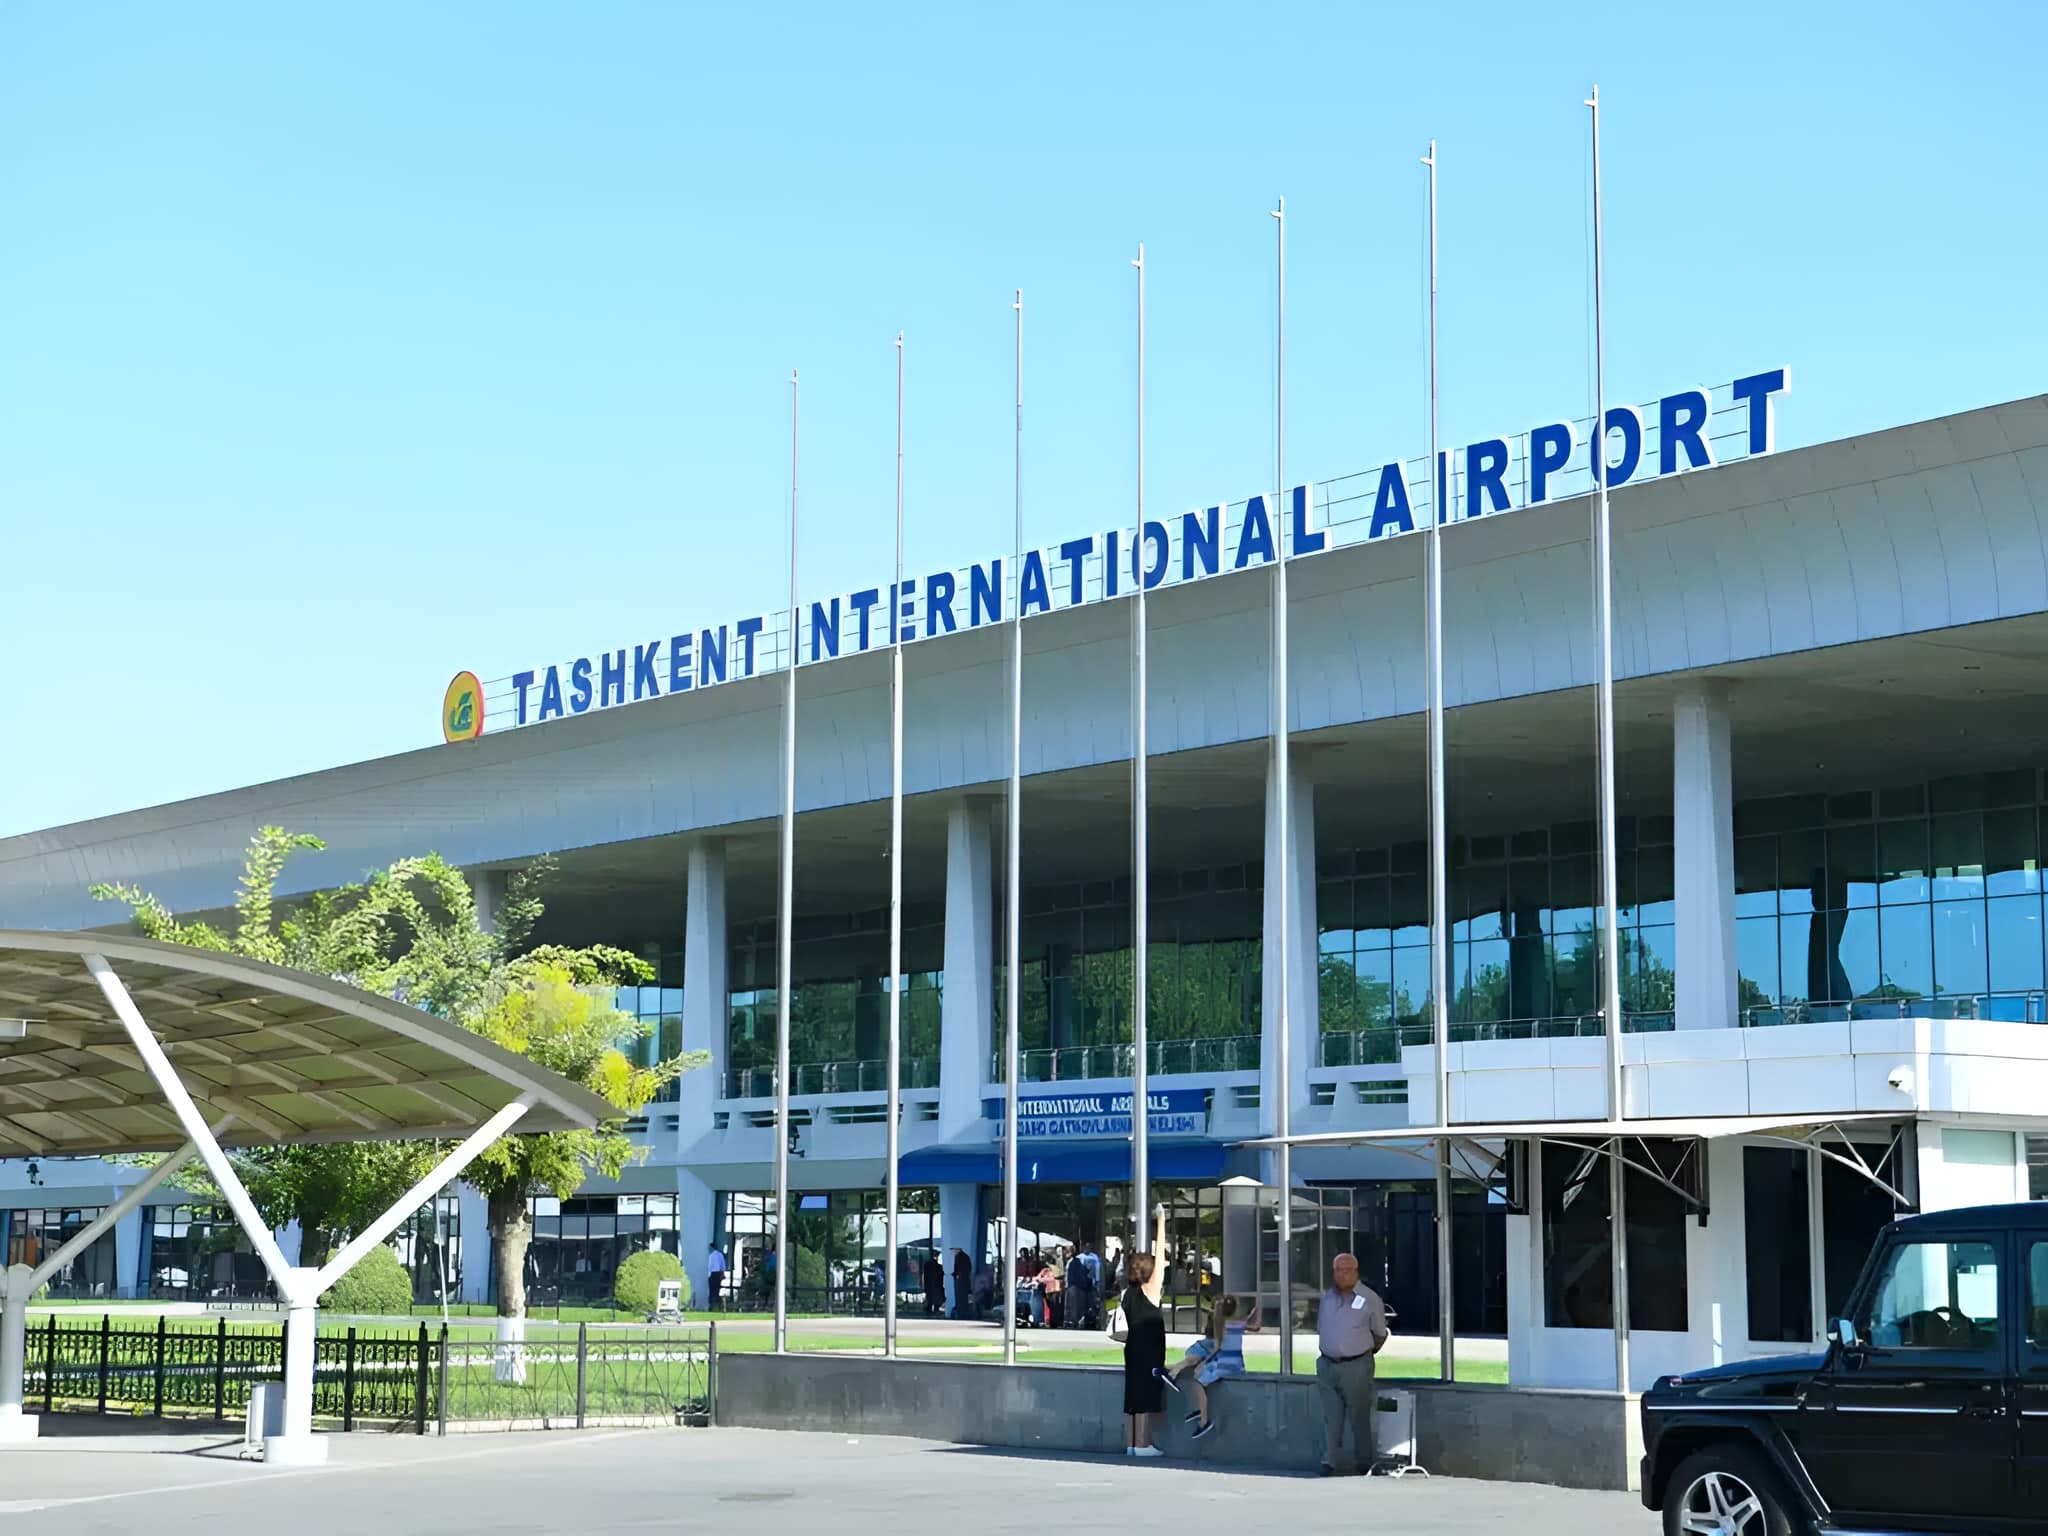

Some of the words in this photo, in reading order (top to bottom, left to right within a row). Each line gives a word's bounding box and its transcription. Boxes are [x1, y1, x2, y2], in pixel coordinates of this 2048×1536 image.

[512, 617, 763, 725] TASHKENT
[1368, 369, 1784, 540] AIRPORT
[1017, 1097, 1104, 1115] NTERNATIONAL
[1111, 1095, 1169, 1112] ARRALS
